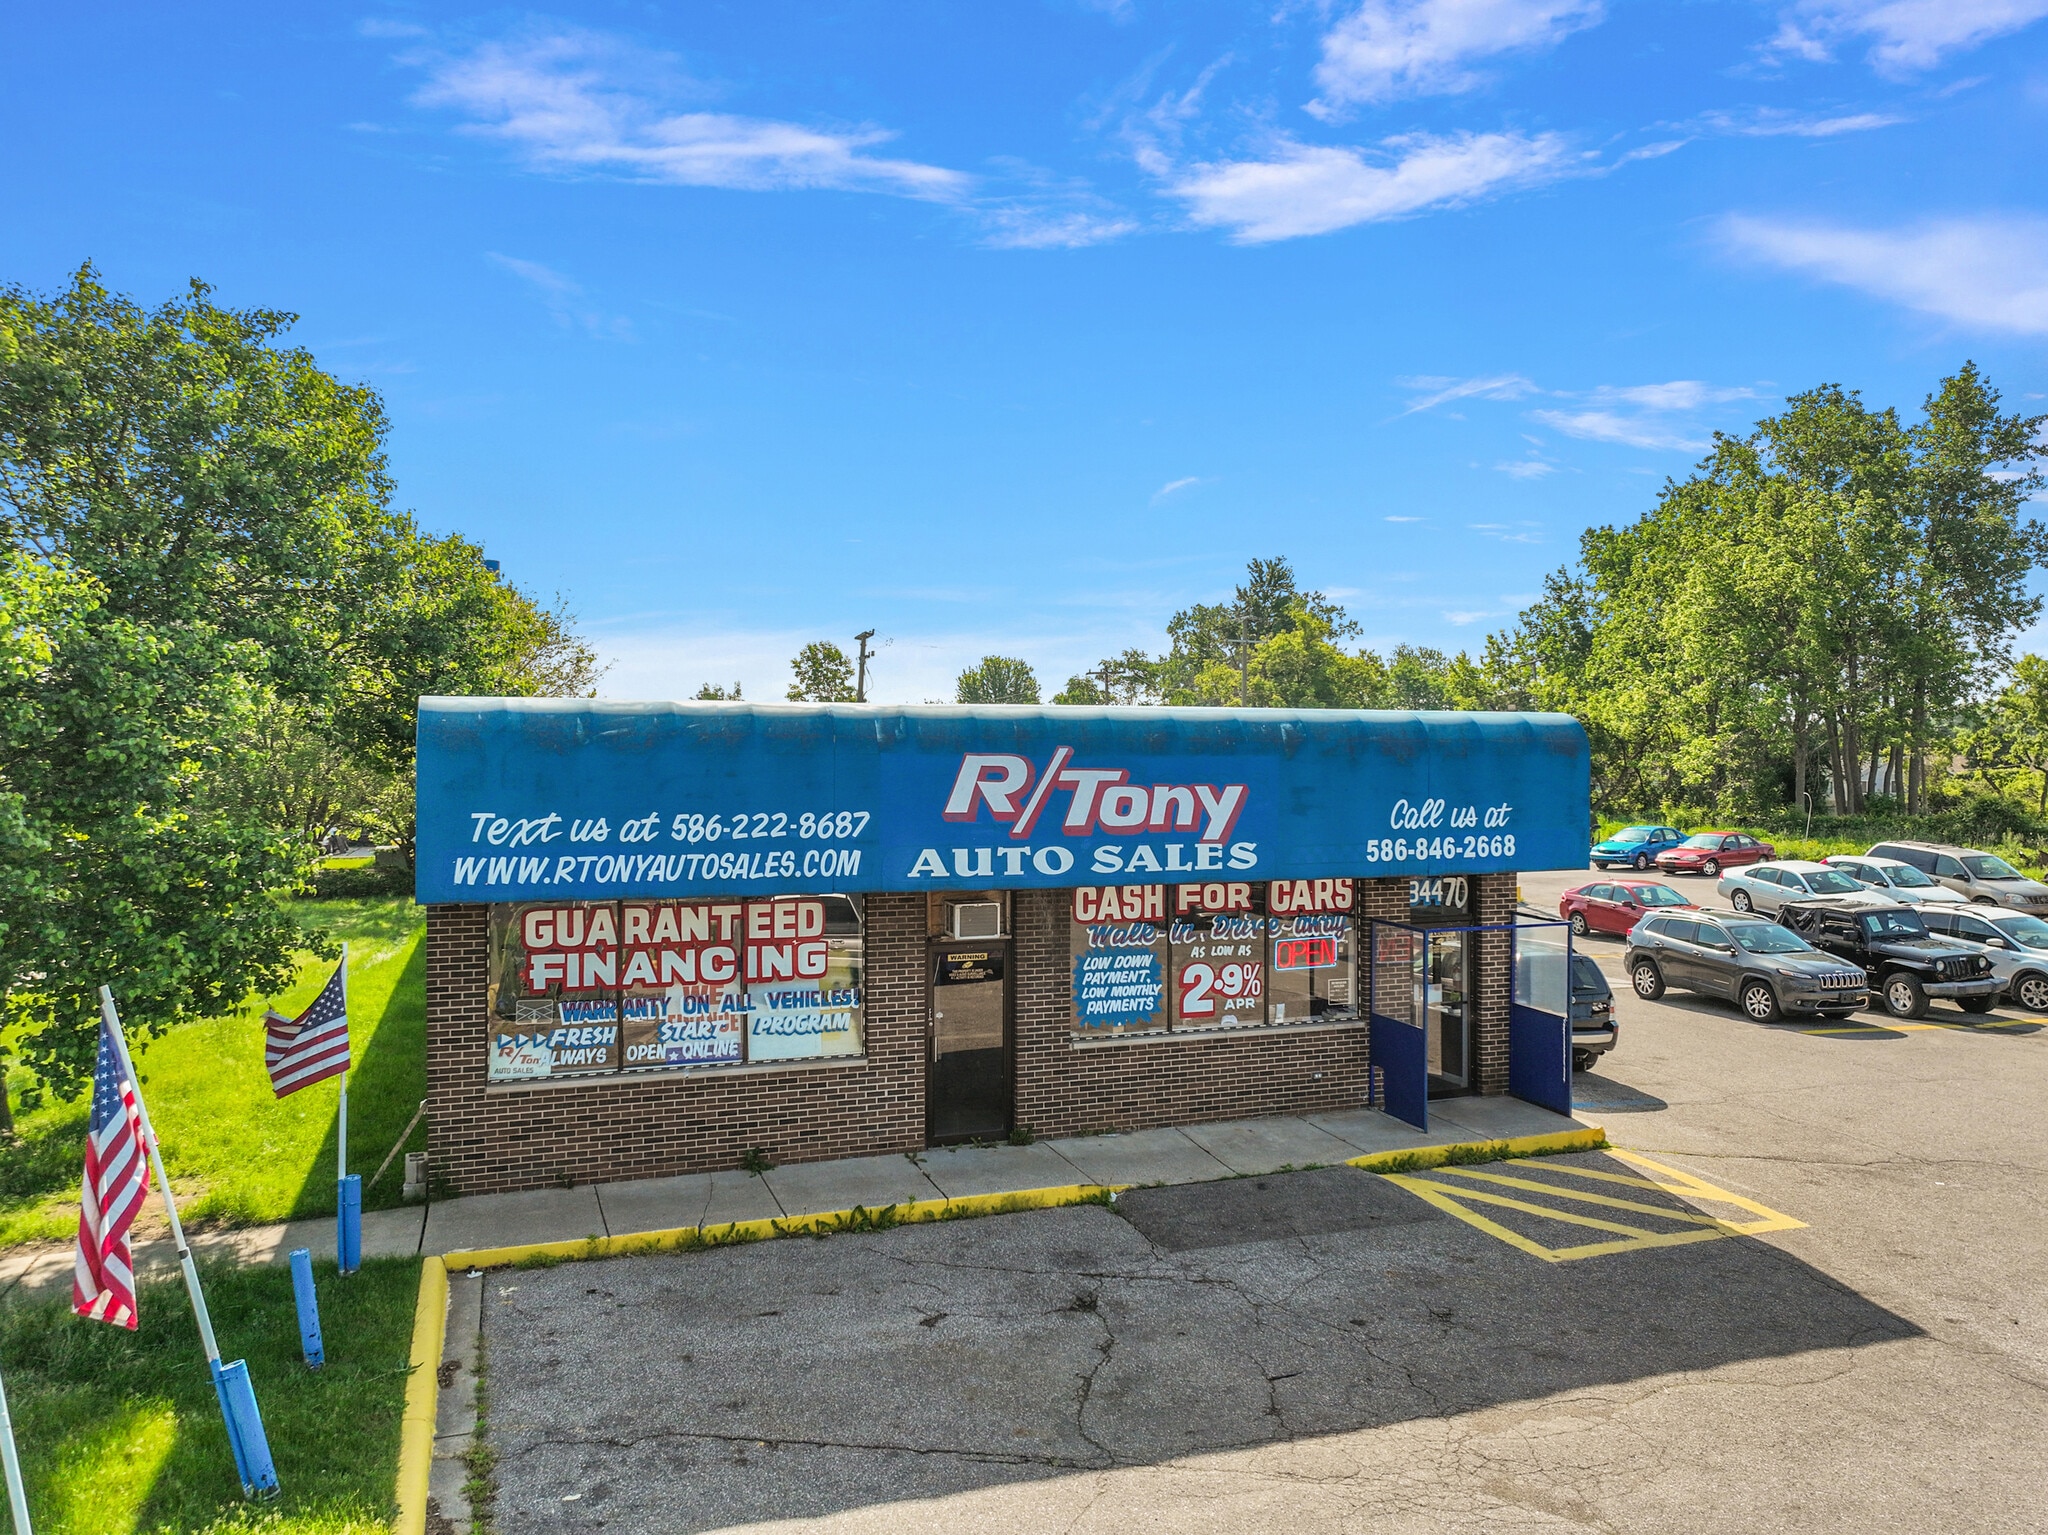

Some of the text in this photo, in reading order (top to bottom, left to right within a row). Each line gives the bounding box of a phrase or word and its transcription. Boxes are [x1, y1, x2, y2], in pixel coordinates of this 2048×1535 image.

[942, 745, 1250, 845] R/Tony
[1390, 798, 1513, 830] Call us at
[470, 811, 870, 848] Text us at 586-222-8687
[907, 842, 1258, 878] AUTO SALES
[1366, 834, 1516, 862] 586-846-2668
[453, 849, 862, 885] WWW.RTONYAUTOSALES.COM
[1073, 878, 1353, 924] CASH FOR CARS
[521, 900, 825, 949] GUARANTEED
[950, 953, 986, 961] WARNING
[1083, 954, 1154, 971] LOW DOWN
[1190, 944, 1252, 959] AS LOW AS
[1277, 939, 1336, 968] OPEN
[527, 941, 829, 994] FINANCING
[681, 993, 711, 1017] ON
[718, 993, 757, 1015] ALL
[764, 988, 861, 1013] VEHICLES!
[1081, 983, 1162, 1000] LOW MONTHLY
[1086, 997, 1154, 1015] PAYMENTS
[1224, 998, 1256, 1010] APR
[545, 1012, 851, 1049] FRESH START PROGRAM
[498, 1046, 545, 1065] R/Ton
[540, 1039, 739, 1067] ALWAYS OPEN ONLINE
[512, 1066, 534, 1074] SALES
